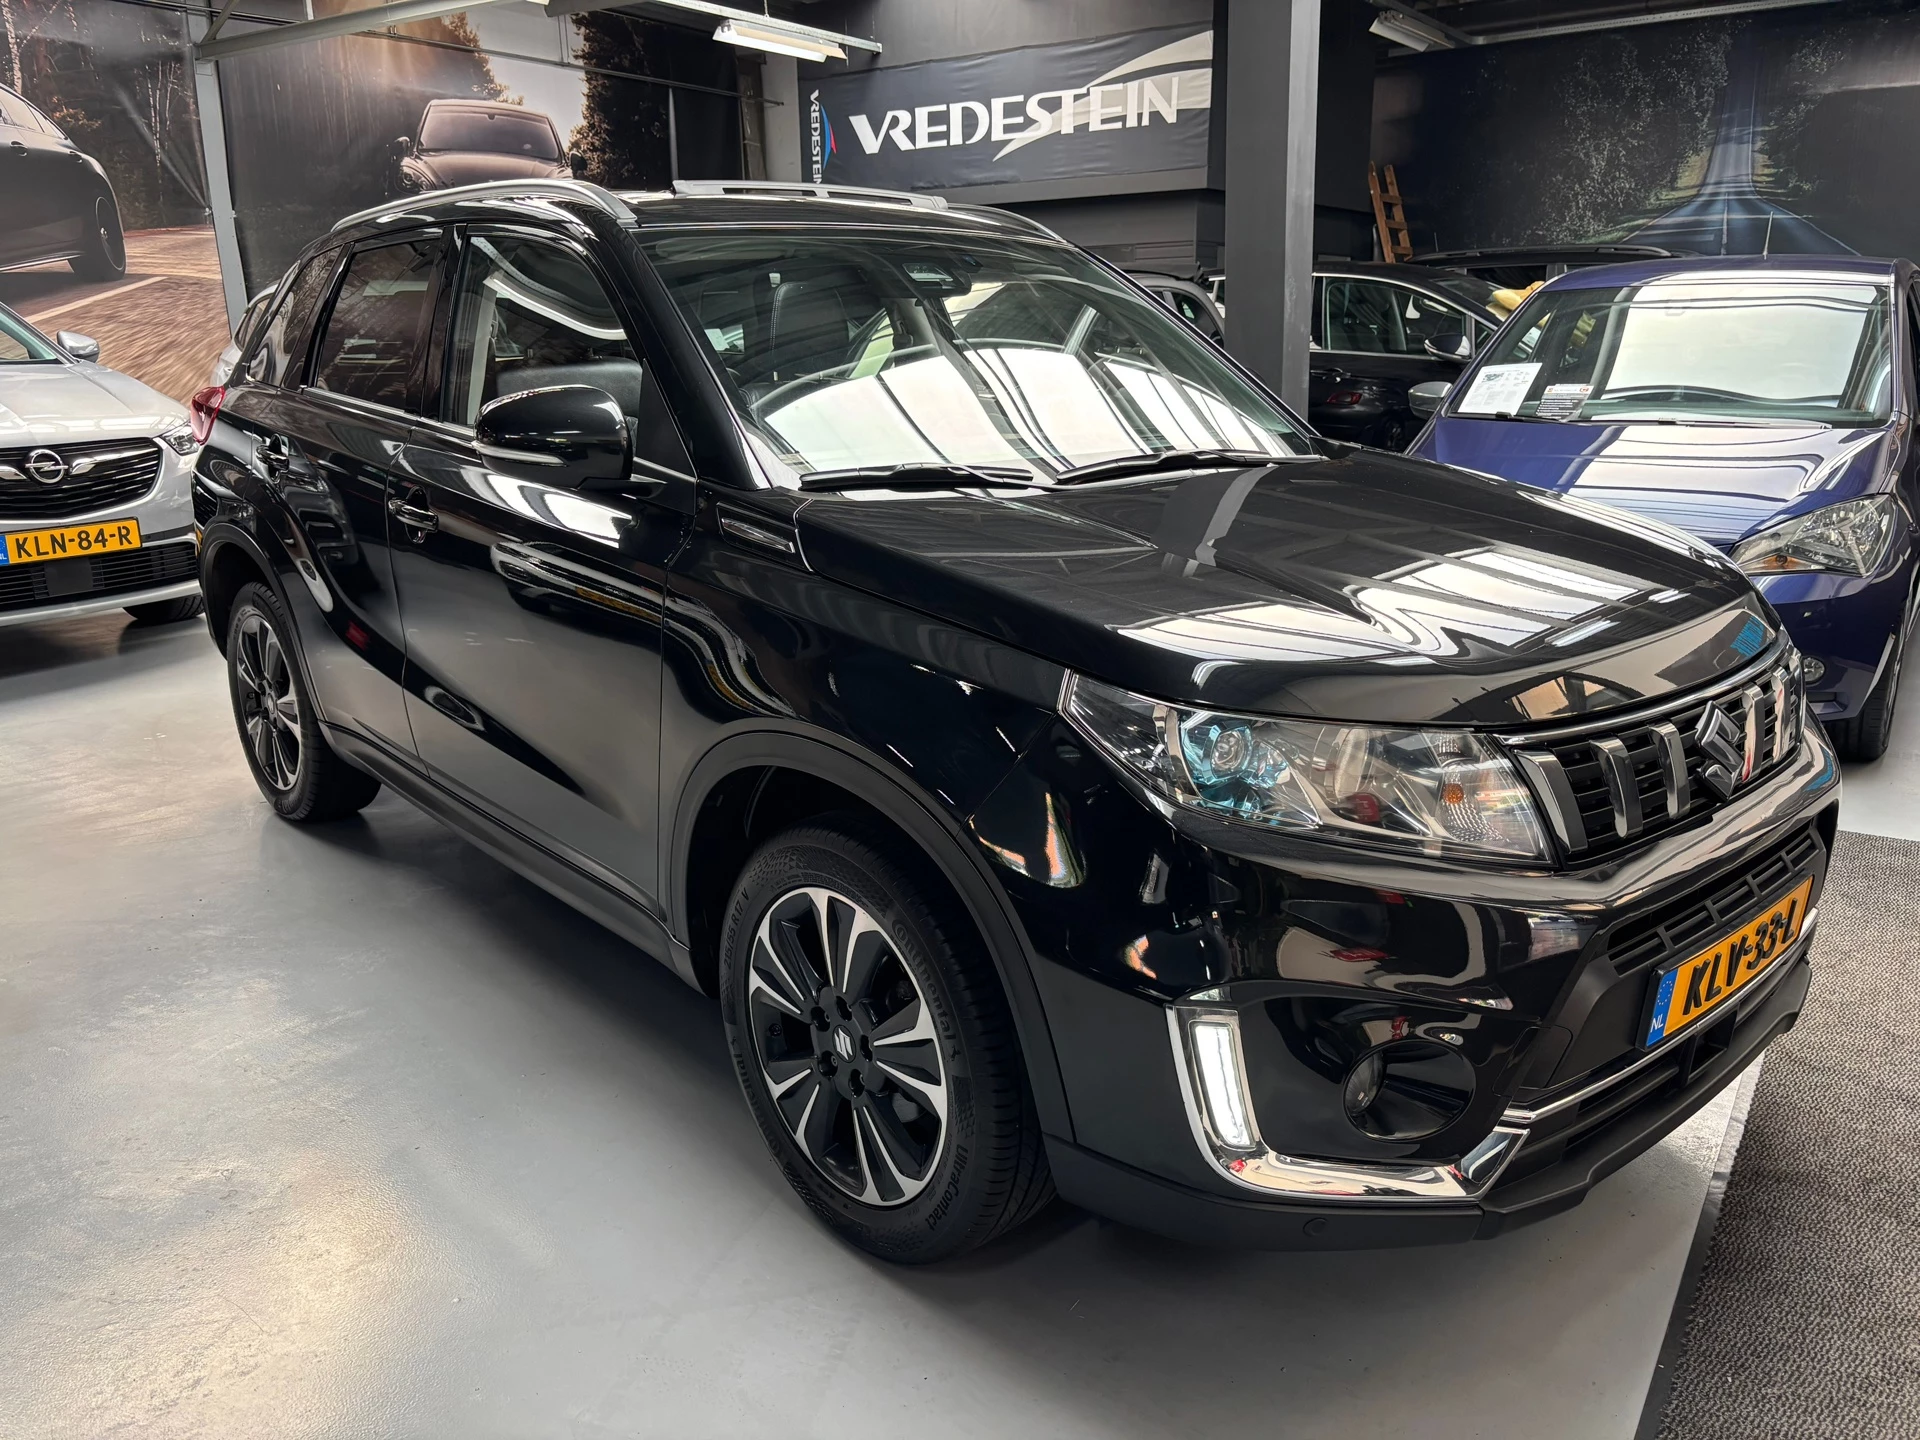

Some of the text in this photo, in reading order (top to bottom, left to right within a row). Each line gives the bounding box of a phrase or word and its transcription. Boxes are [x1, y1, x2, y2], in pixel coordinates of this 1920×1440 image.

[849, 76, 1180, 161] VREDESTEIN
[15, 525, 132, 558] KLN-84-R
[723, 926, 736, 970] 215/55
[891, 918, 956, 1040] Continental
[1681, 897, 1798, 1016] KLV-33-L
[1650, 1013, 1665, 1033] NL
[924, 1143, 969, 1232] UltraContact
